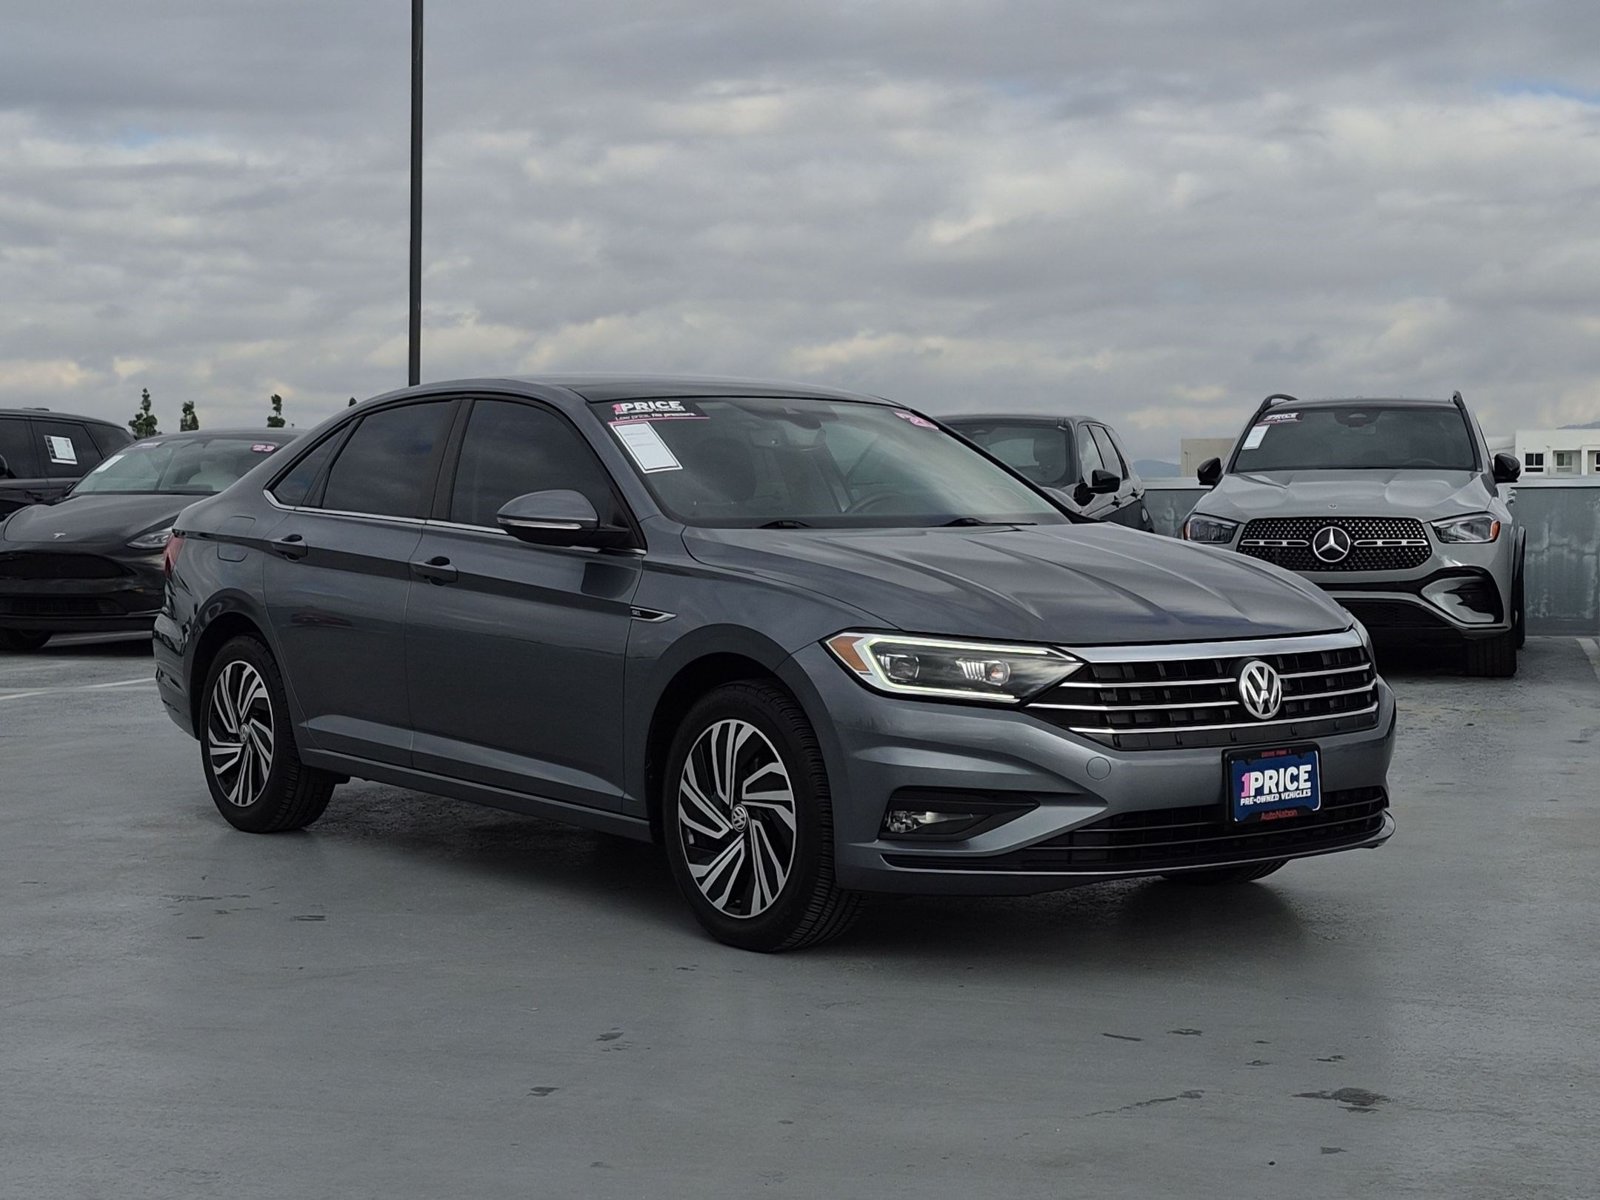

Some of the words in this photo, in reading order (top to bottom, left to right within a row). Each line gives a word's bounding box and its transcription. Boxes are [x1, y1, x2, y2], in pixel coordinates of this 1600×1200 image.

[1240, 764, 1312, 798] 1PRICE
[1240, 793, 1280, 807] PRE-OWNED
[1281, 788, 1312, 801] VEHICLES
